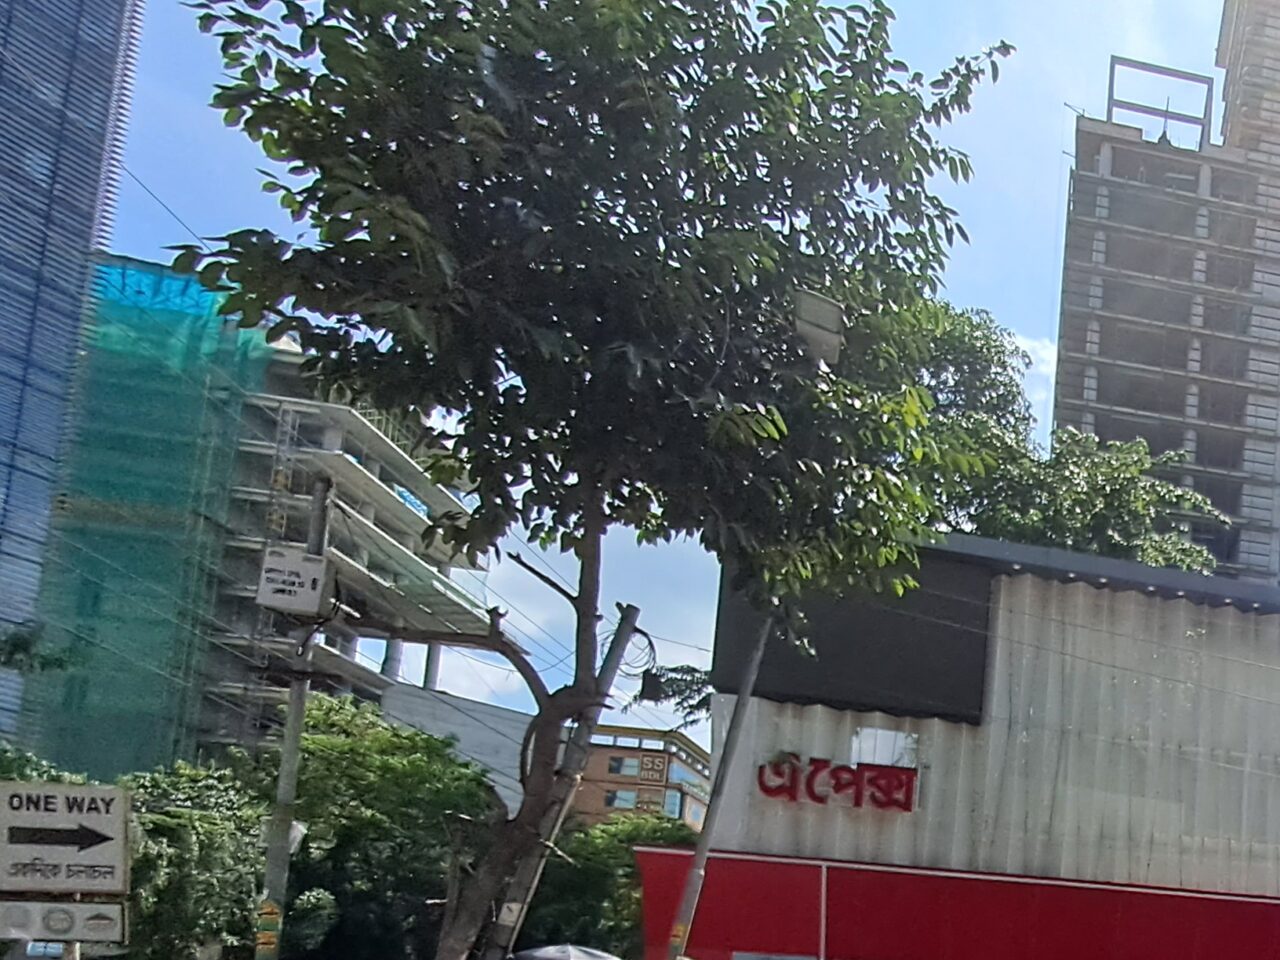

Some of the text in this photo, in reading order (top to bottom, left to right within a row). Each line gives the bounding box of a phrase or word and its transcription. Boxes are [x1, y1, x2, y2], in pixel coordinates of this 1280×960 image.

[642, 757, 664, 770] SS
[758, 752, 918, 812] এপেক্স
[8, 793, 116, 814] ONE WAY
